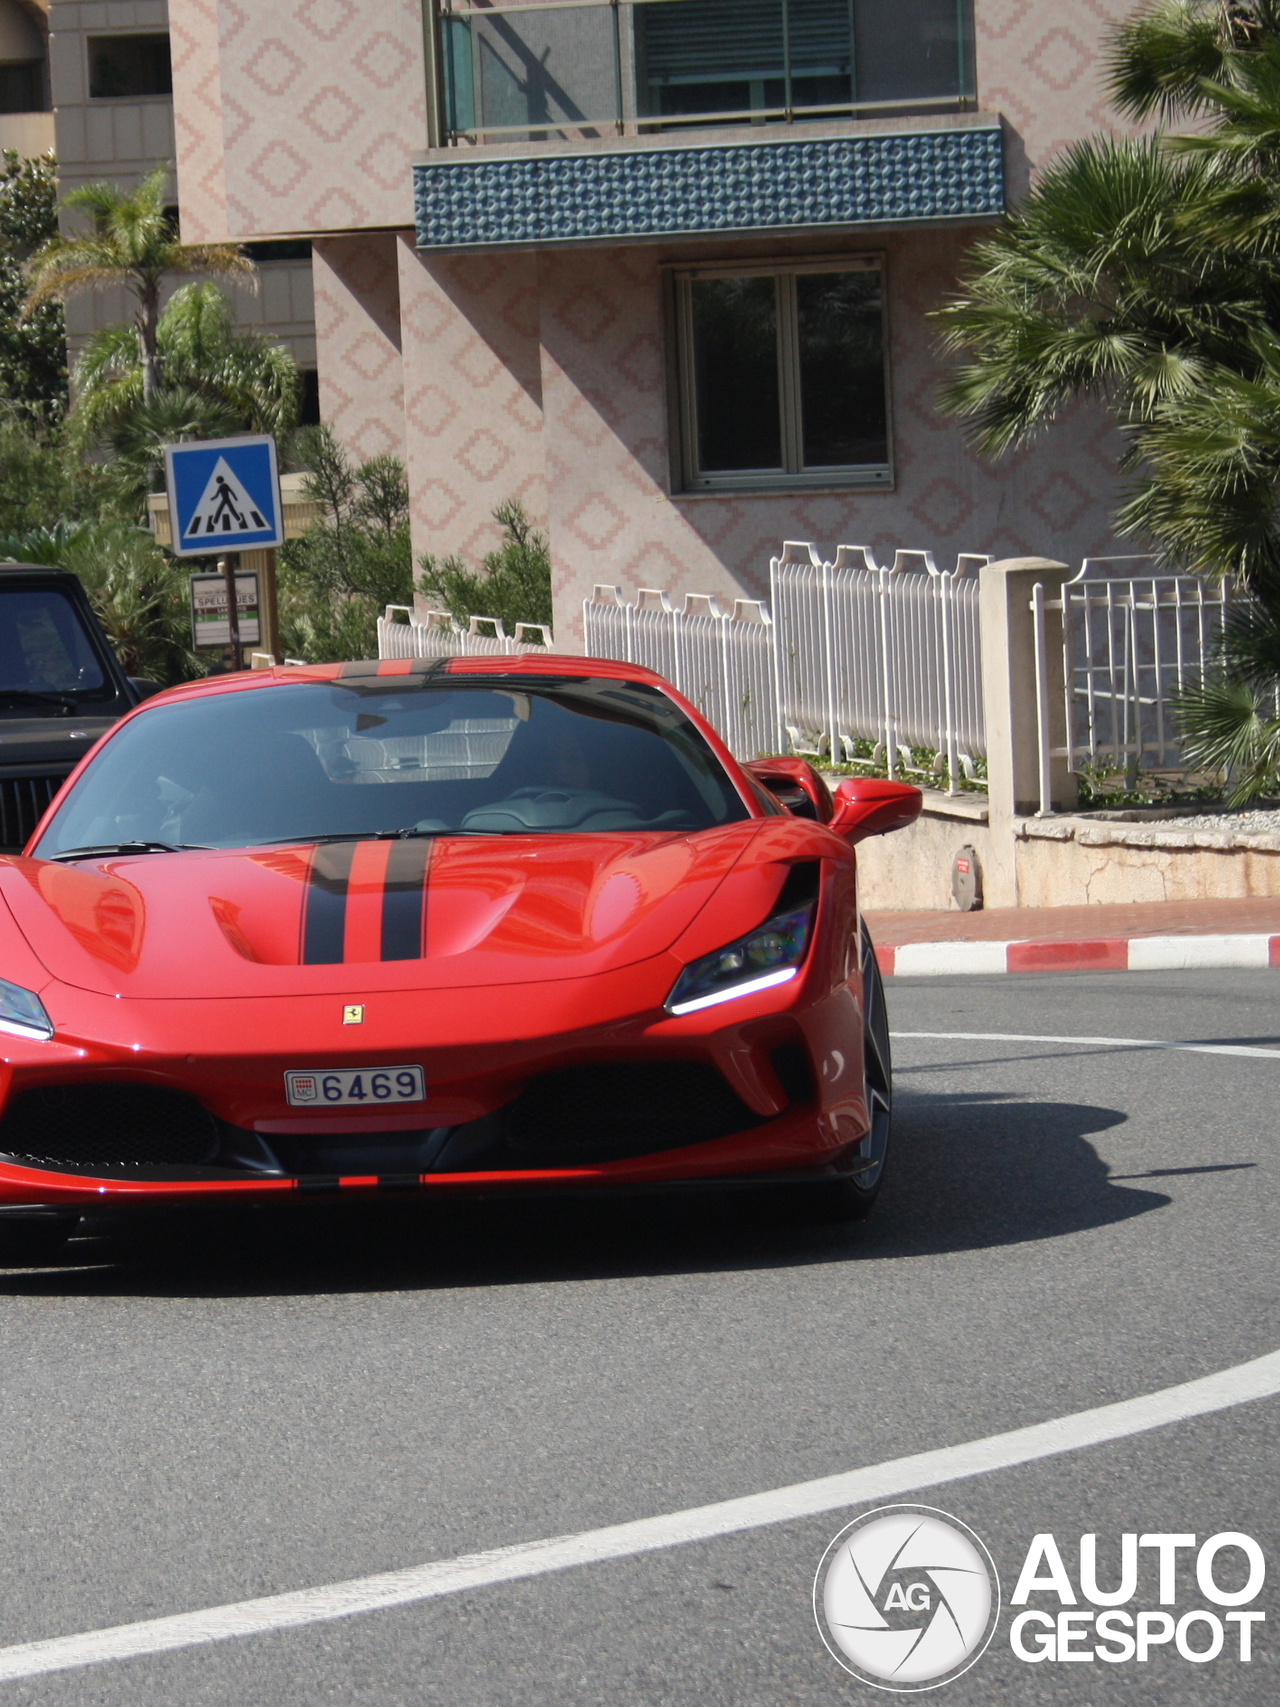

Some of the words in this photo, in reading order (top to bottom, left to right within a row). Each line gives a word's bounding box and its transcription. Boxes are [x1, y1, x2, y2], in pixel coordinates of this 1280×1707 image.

[198, 595, 255, 606] SPELUUES
[297, 1089, 312, 1097] MC
[322, 1072, 416, 1101] 6469
